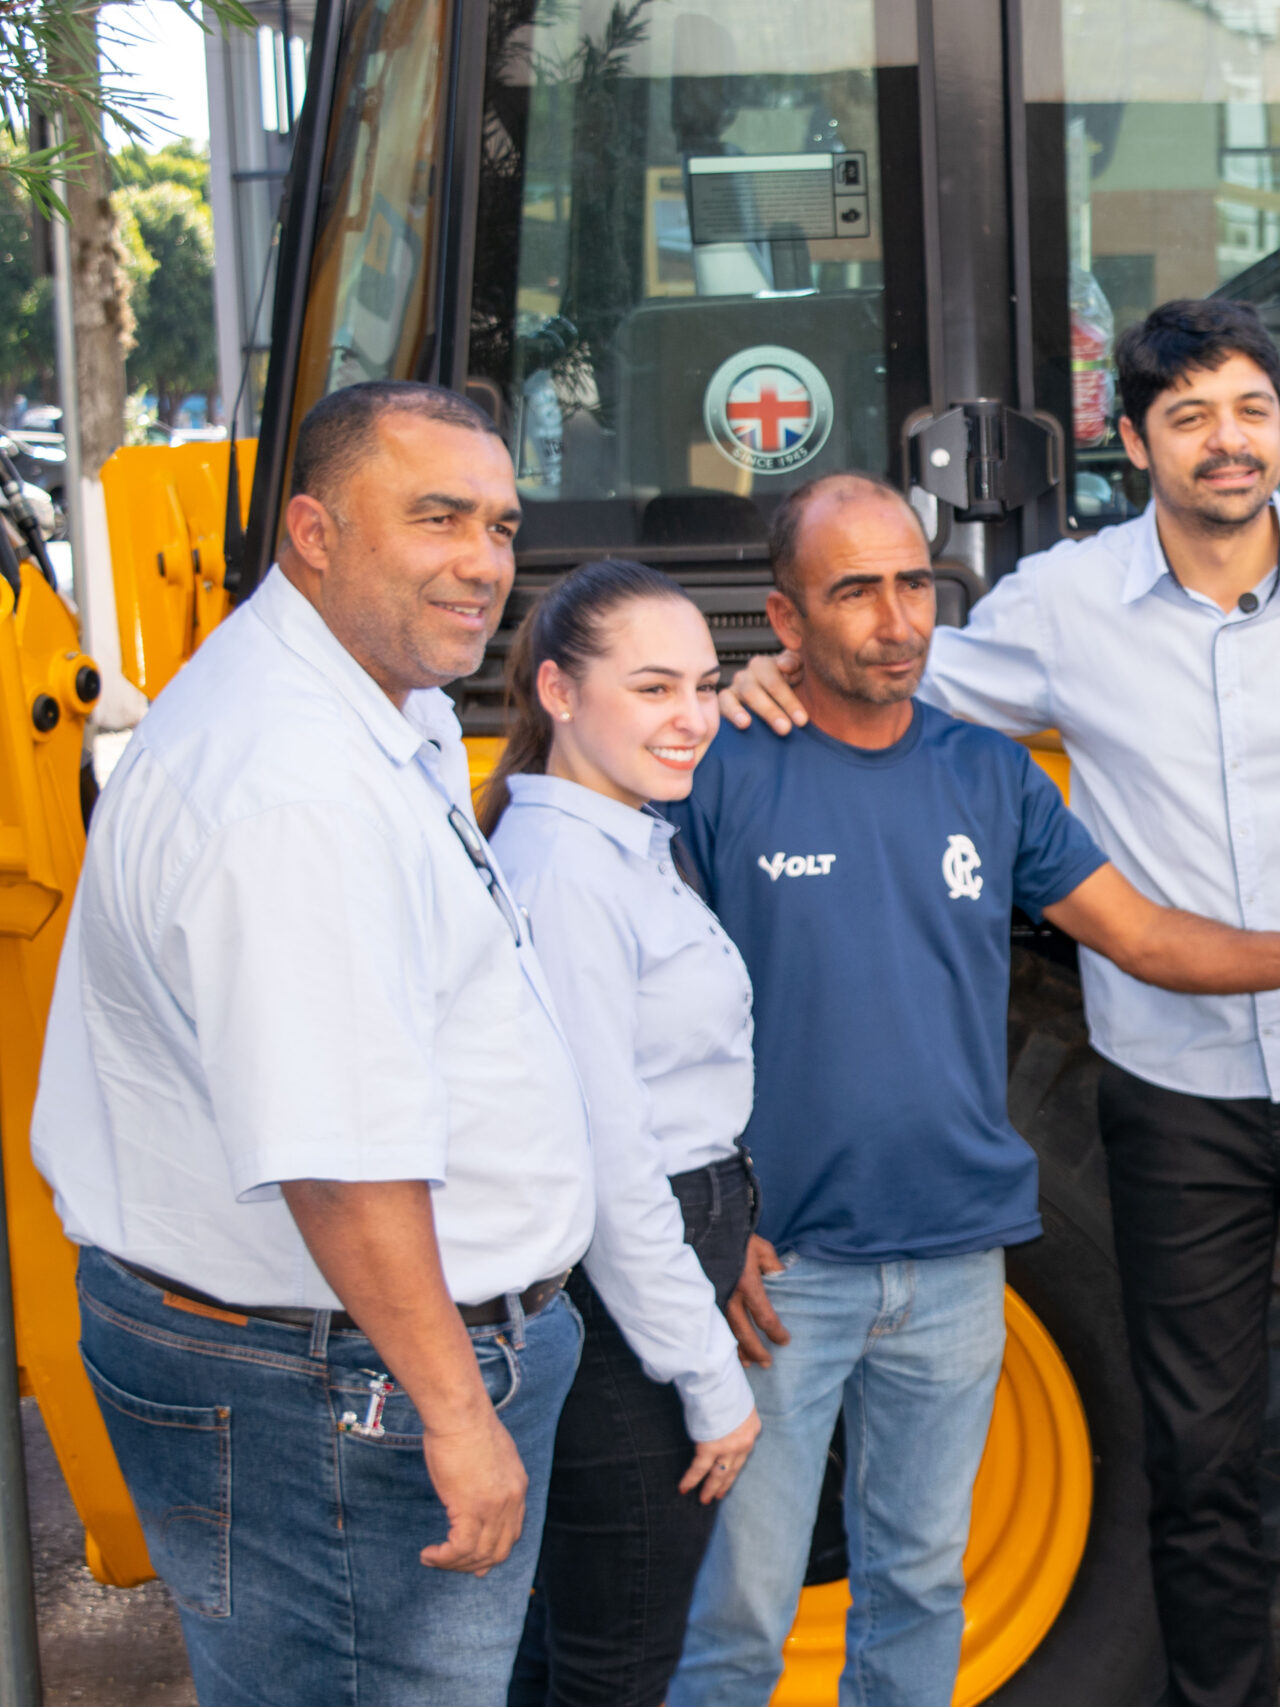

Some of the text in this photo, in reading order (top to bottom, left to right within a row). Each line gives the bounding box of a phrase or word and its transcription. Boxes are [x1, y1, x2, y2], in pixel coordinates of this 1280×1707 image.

[732, 446, 809, 469] SINCE 1945
[757, 852, 837, 882] VOLT
